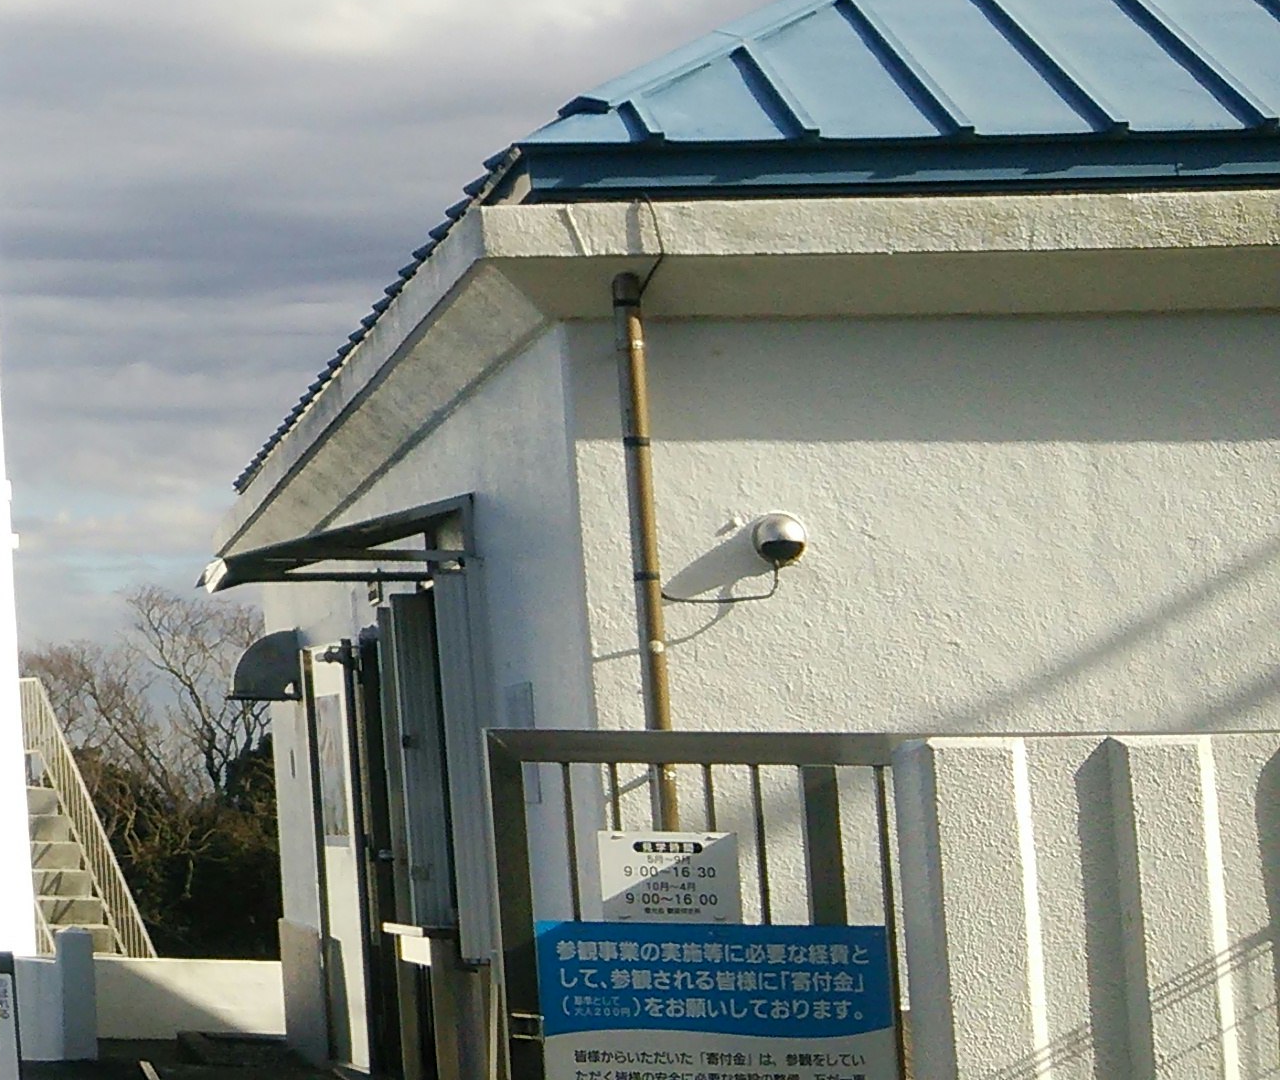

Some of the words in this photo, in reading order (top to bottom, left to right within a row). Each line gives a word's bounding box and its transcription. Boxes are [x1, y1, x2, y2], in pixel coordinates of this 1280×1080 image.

[556, 940, 869, 965] 参観事業の実施等に必要な経費と
[560, 968, 864, 993] して、参観される皆様に「寄付金」
